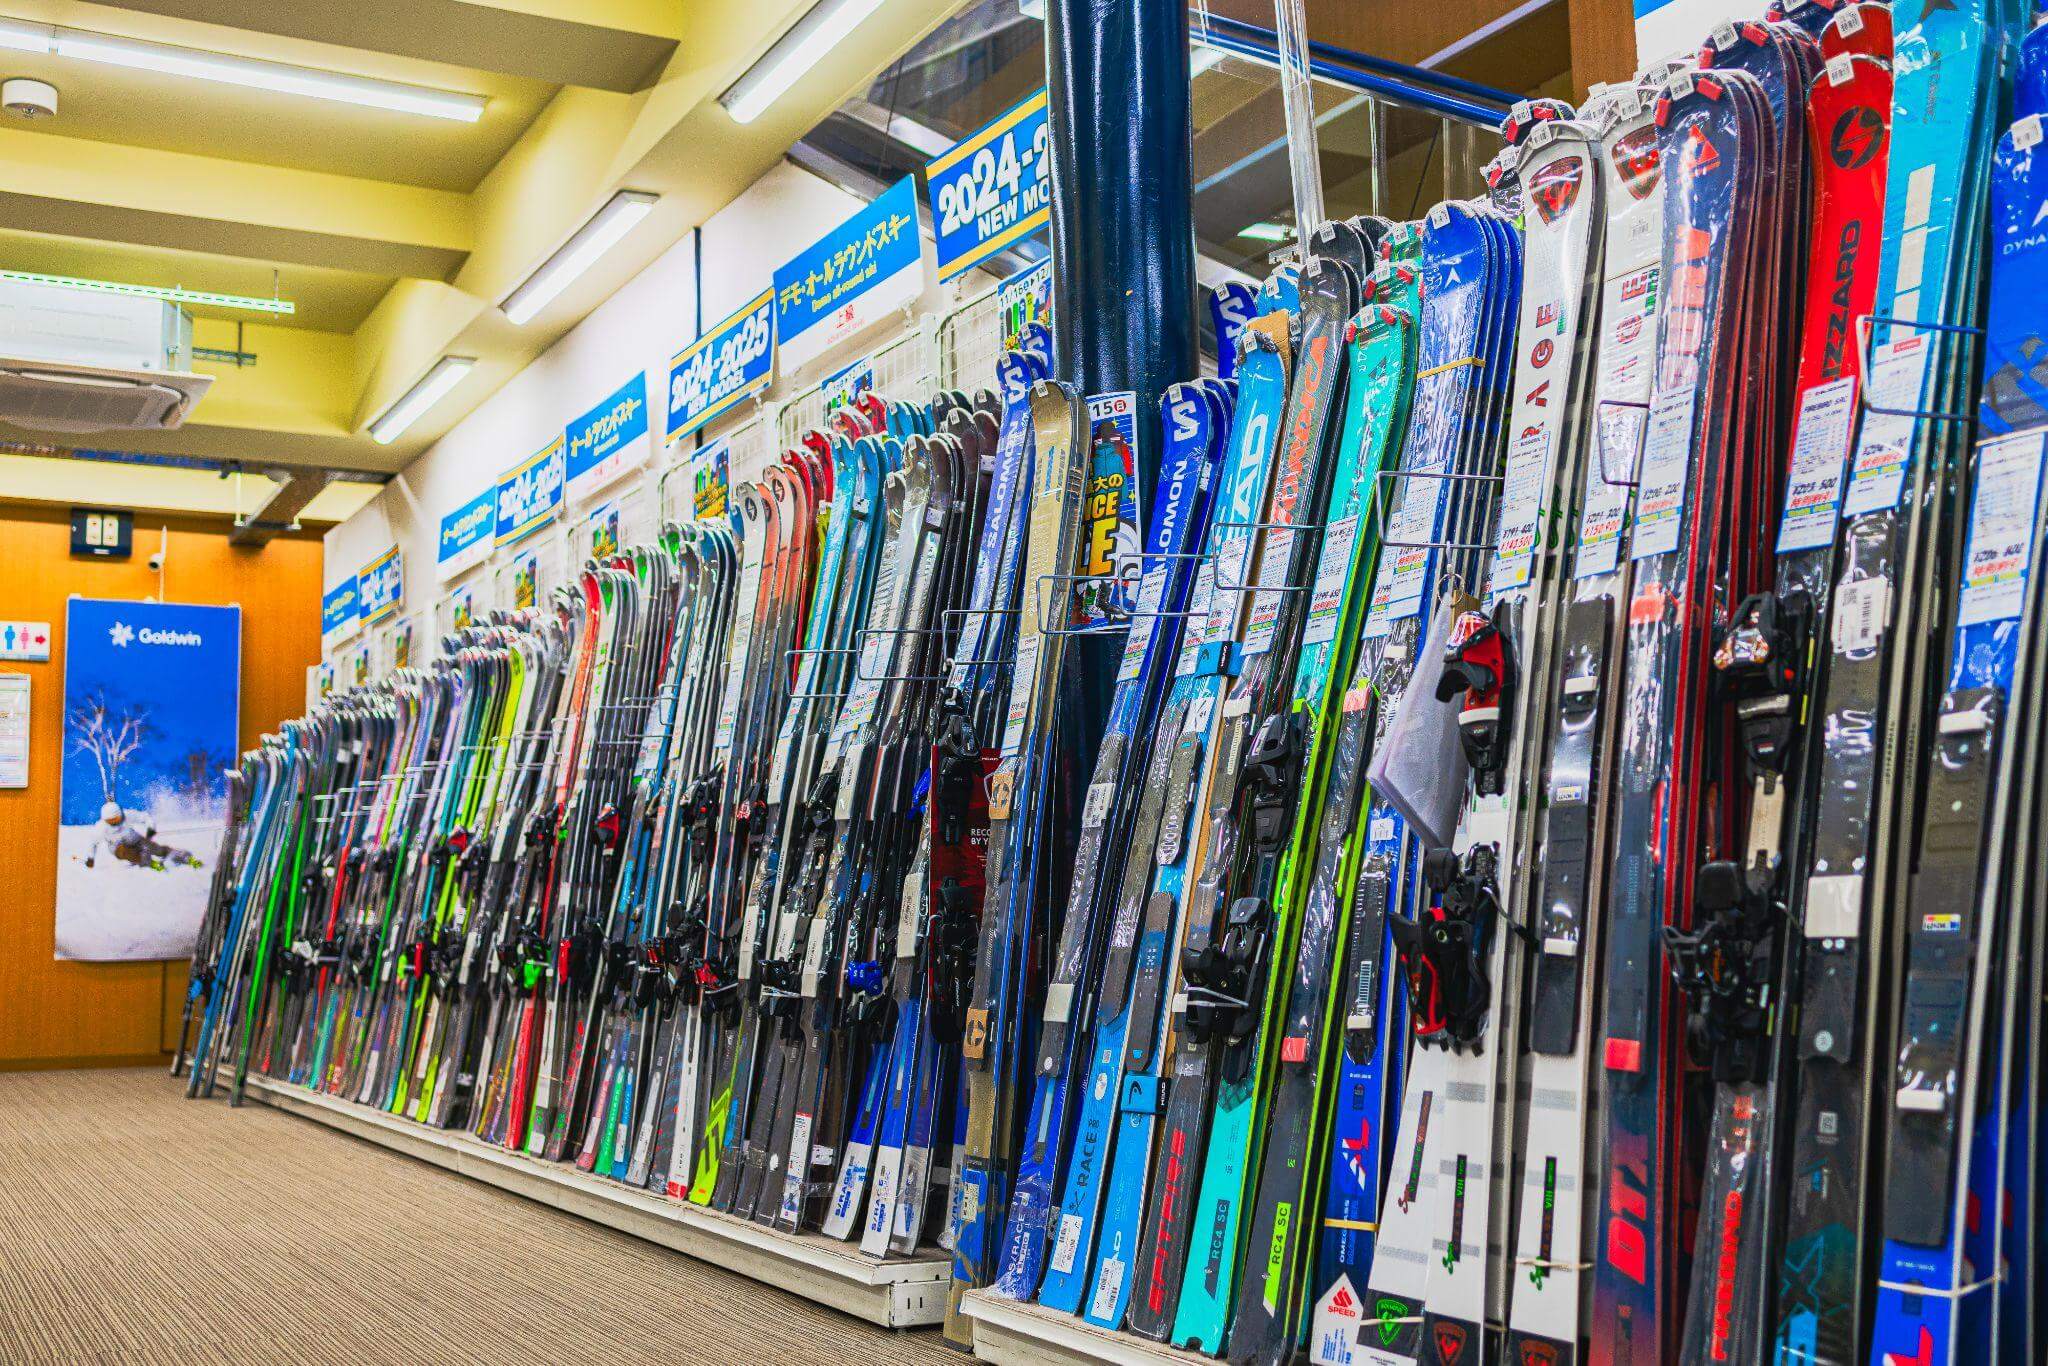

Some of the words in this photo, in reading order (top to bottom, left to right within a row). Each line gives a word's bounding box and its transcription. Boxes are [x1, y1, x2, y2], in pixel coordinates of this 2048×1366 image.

[938, 122, 1048, 237] 2024-2
[978, 196, 1018, 241] NEW
[1822, 219, 1861, 379] IZZARD
[671, 303, 770, 413] 2024-2025
[1171, 401, 1200, 442] S
[987, 421, 1020, 549] SALOMON
[138, 628, 202, 647] Goldwin
[1076, 1132, 1097, 1187] RACE
[1210, 1229, 1222, 1260] RC4
[1216, 1203, 1227, 1223] SC
[1272, 1234, 1284, 1265] RC4
[1278, 1207, 1288, 1227] SC
[1340, 1199, 1350, 1263] OMEGASS
[1327, 1305, 1356, 1318] SPEED
